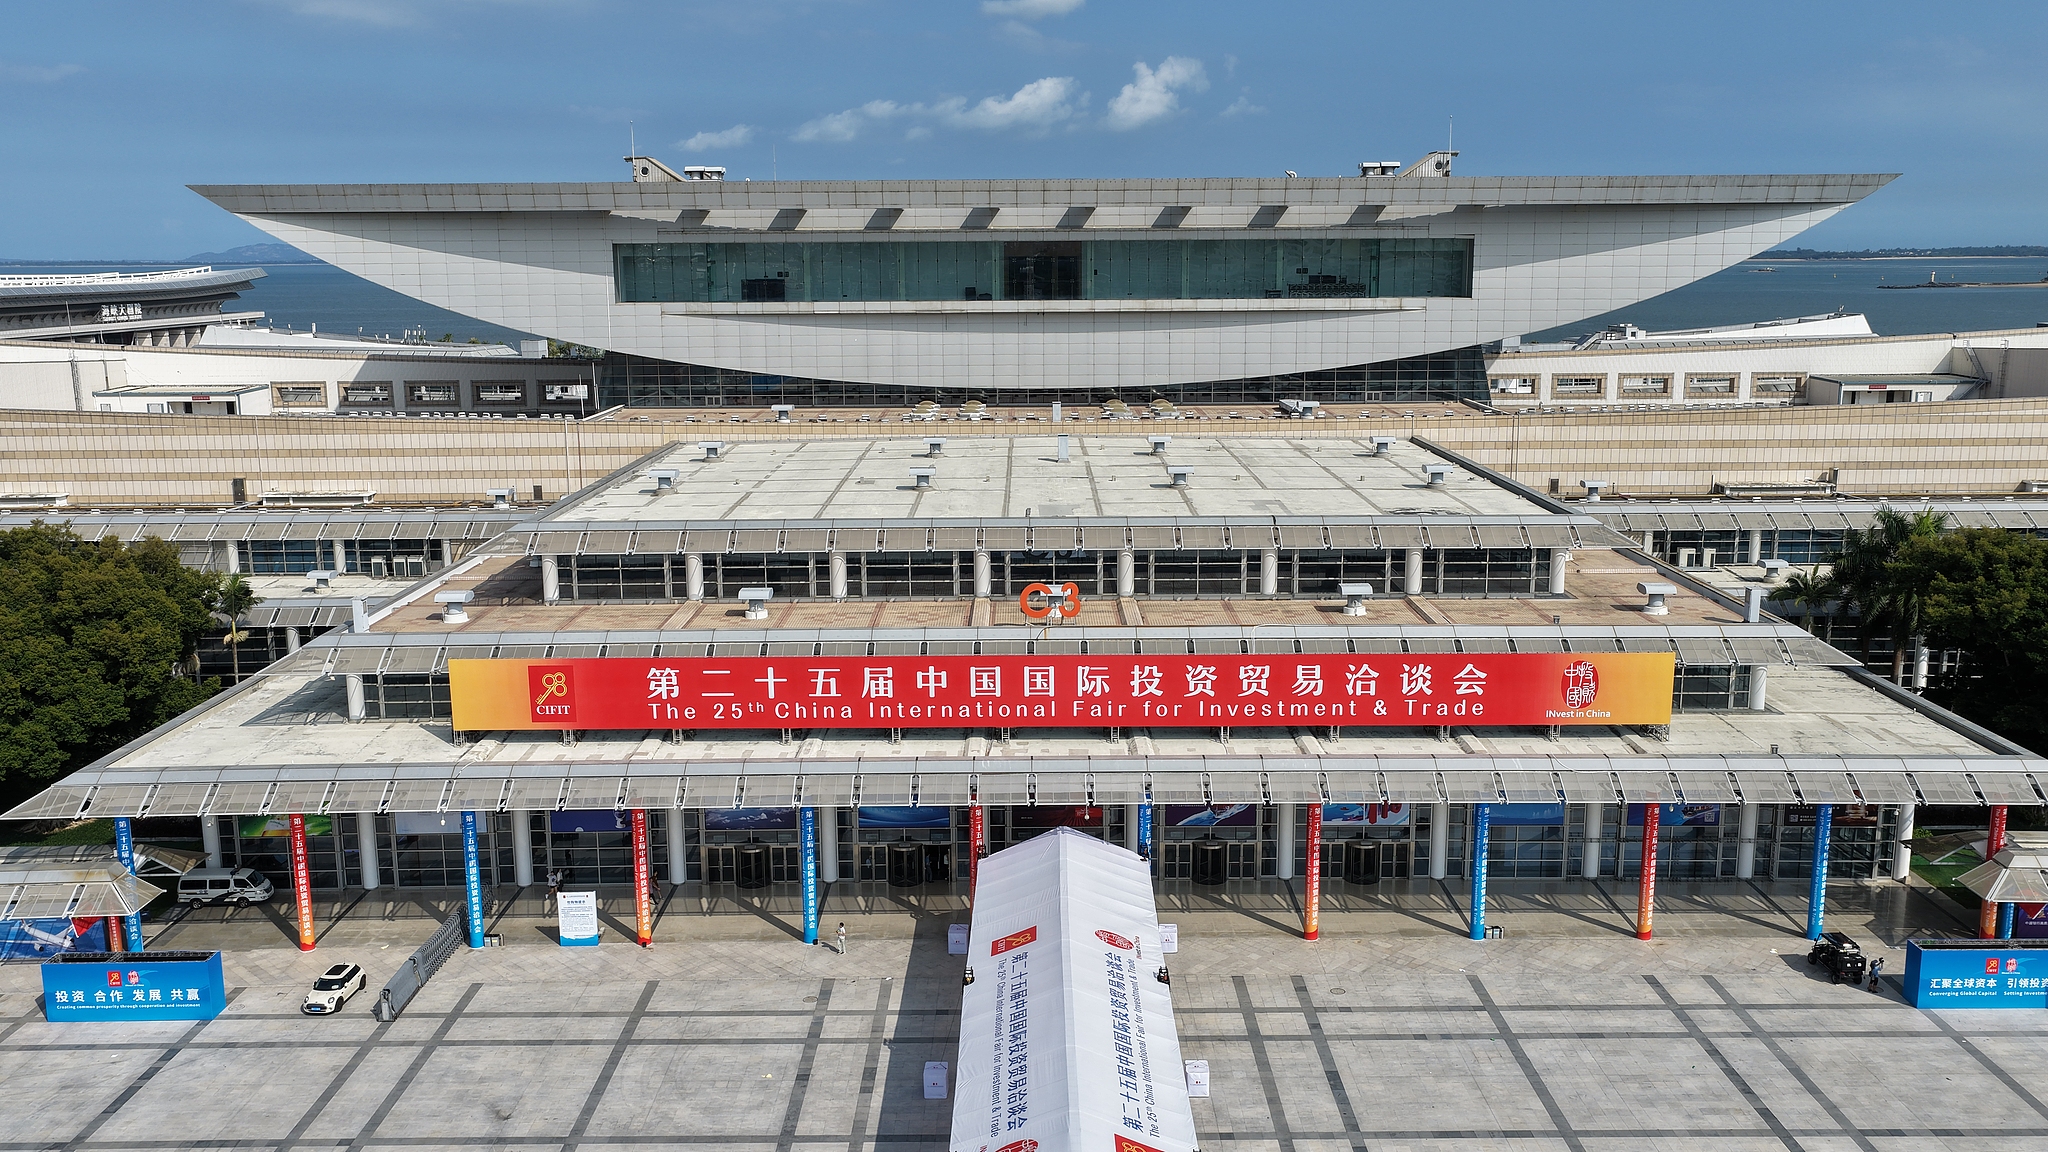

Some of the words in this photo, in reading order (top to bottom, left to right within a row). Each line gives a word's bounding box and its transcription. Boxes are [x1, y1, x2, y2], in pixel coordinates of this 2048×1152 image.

[1020, 582, 1080, 618] C3
[647, 665, 1488, 700] 第二十五届中国国际投资贸易洽谈会
[536, 705, 570, 715] CIFIT
[648, 703, 696, 719] The
[714, 701, 764, 719] 25th
[775, 702, 853, 719] China
[870, 701, 1055, 718] International
[1073, 701, 1127, 718] Fair
[1142, 701, 1183, 717] for
[1199, 701, 1357, 717] Investment
[1374, 701, 1388, 716] &
[1404, 700, 1484, 716] Trade
[1545, 710, 1575, 718] INvest
[1576, 710, 1585, 718] in
[1586, 710, 1611, 718] China
[998, 958, 1007, 970] The
[1930, 978, 1997, 989] 汇聚全球资本
[55, 990, 85, 1003] 投资
[93, 990, 124, 1003] 合作
[132, 989, 162, 1002] 发展
[170, 988, 200, 1001] 共赢
[1134, 1014, 1144, 1024] for
[1135, 1025, 1146, 1039] Fair
[993, 1037, 1004, 1051] Fair
[1007, 951, 1029, 1131] 第二十五届中国国际投资贸易洽谈会
[993, 1052, 1003, 1063] for
[991, 1064, 1003, 1106] Investment
[1143, 1084, 1155, 1105] China
[990, 1113, 1002, 1138] Trade
[1149, 1123, 1160, 1138] The
